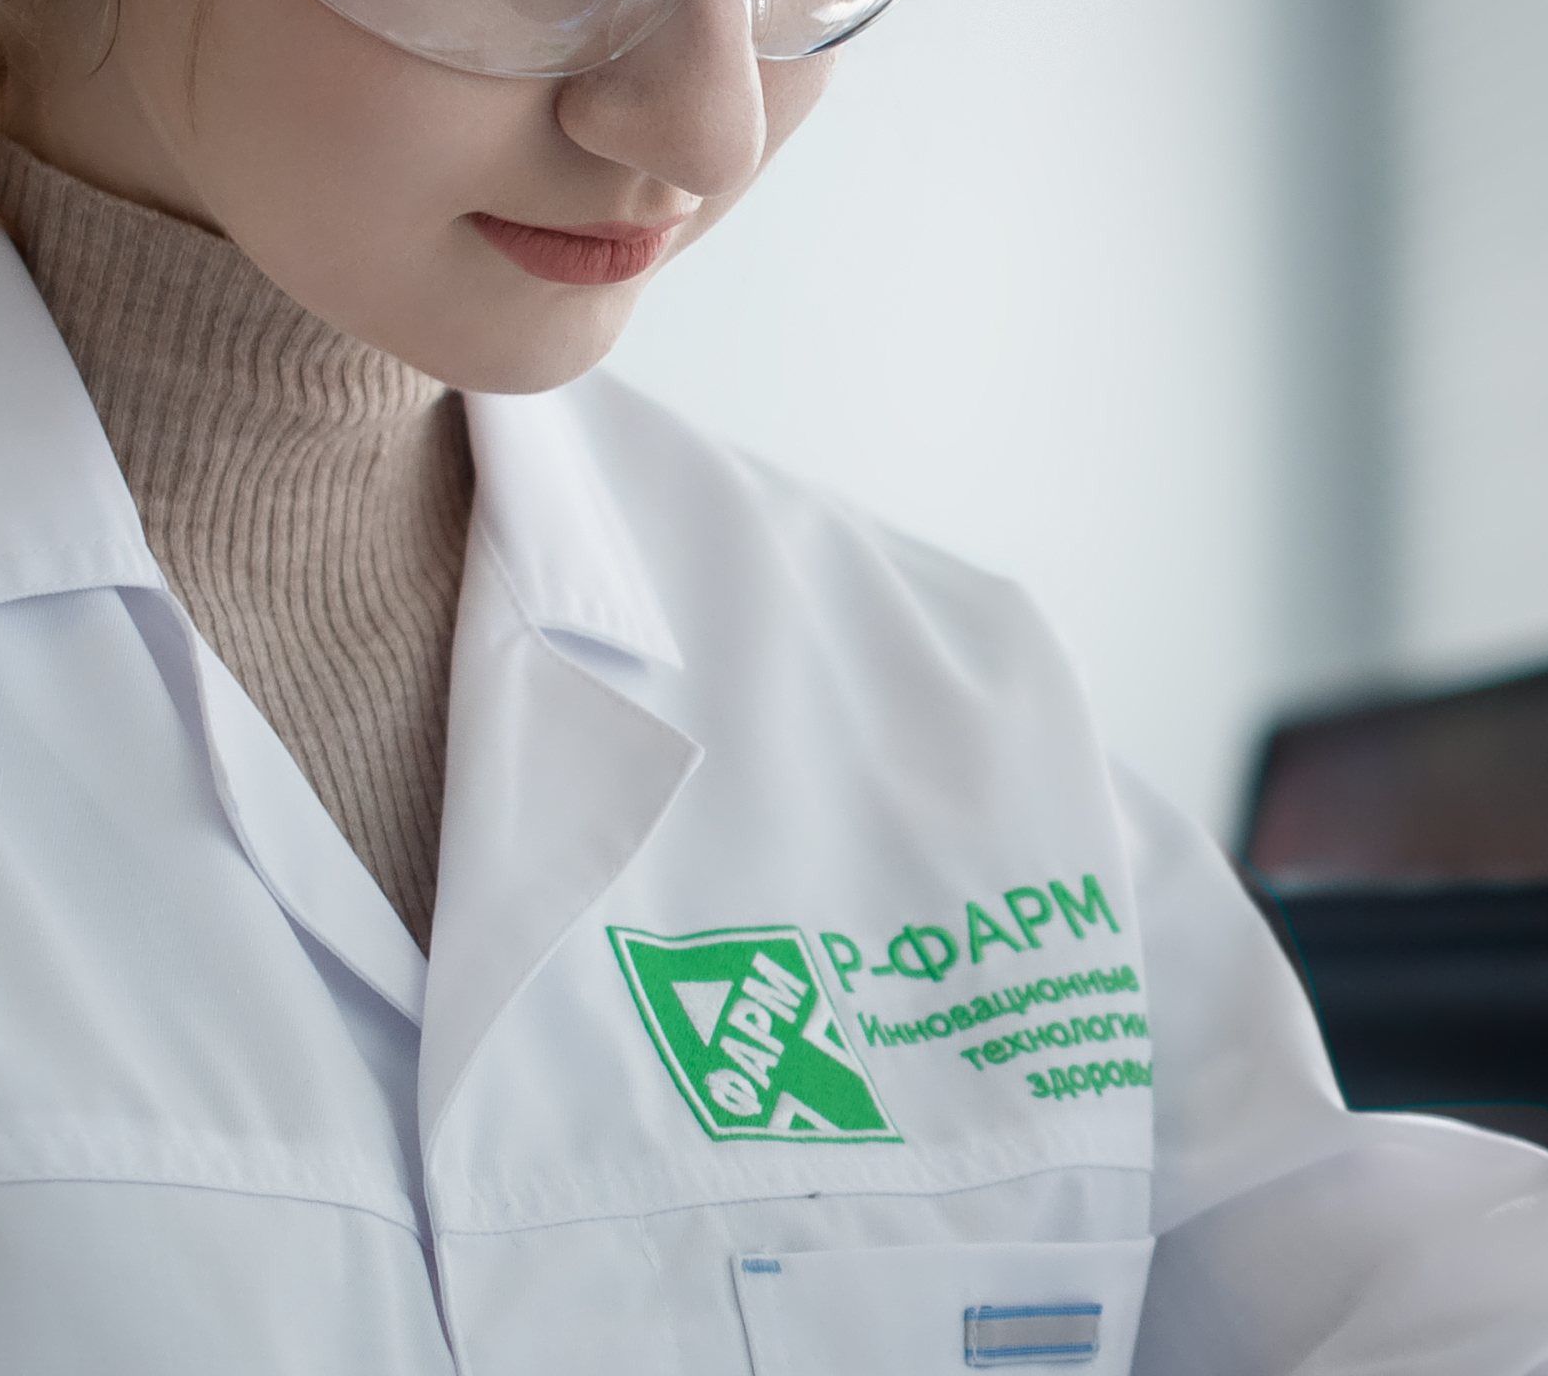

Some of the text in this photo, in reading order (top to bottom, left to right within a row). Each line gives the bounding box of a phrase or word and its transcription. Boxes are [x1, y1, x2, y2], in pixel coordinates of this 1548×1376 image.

[819, 874, 1121, 994] Р-ФАРМ
[704, 950, 811, 1118] ФАРМ
[856, 964, 1141, 1047] Инновационные
[1025, 1058, 1154, 1102] здоровь
